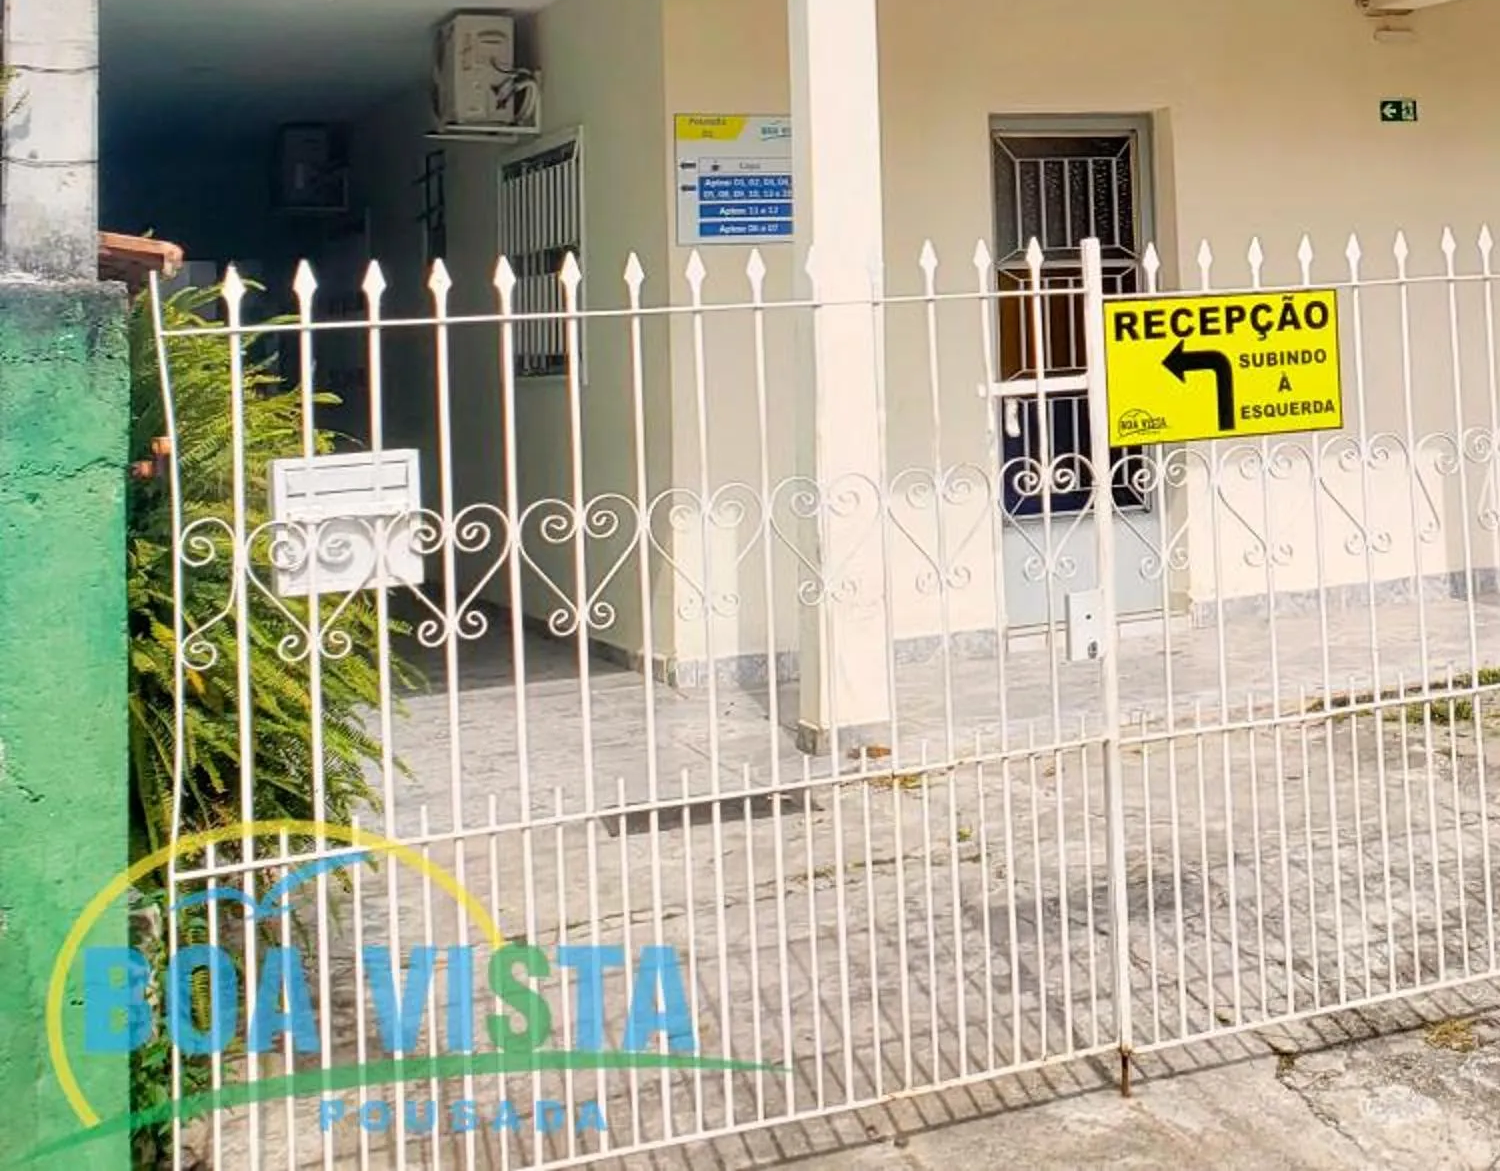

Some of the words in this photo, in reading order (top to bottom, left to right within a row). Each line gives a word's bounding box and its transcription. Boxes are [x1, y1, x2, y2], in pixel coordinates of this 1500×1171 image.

[1114, 295, 1329, 342] RECEPÇÃO
[1239, 348, 1328, 369] SUBINDO
[1278, 372, 1293, 392] À
[1240, 399, 1336, 420] ESQUERDA
